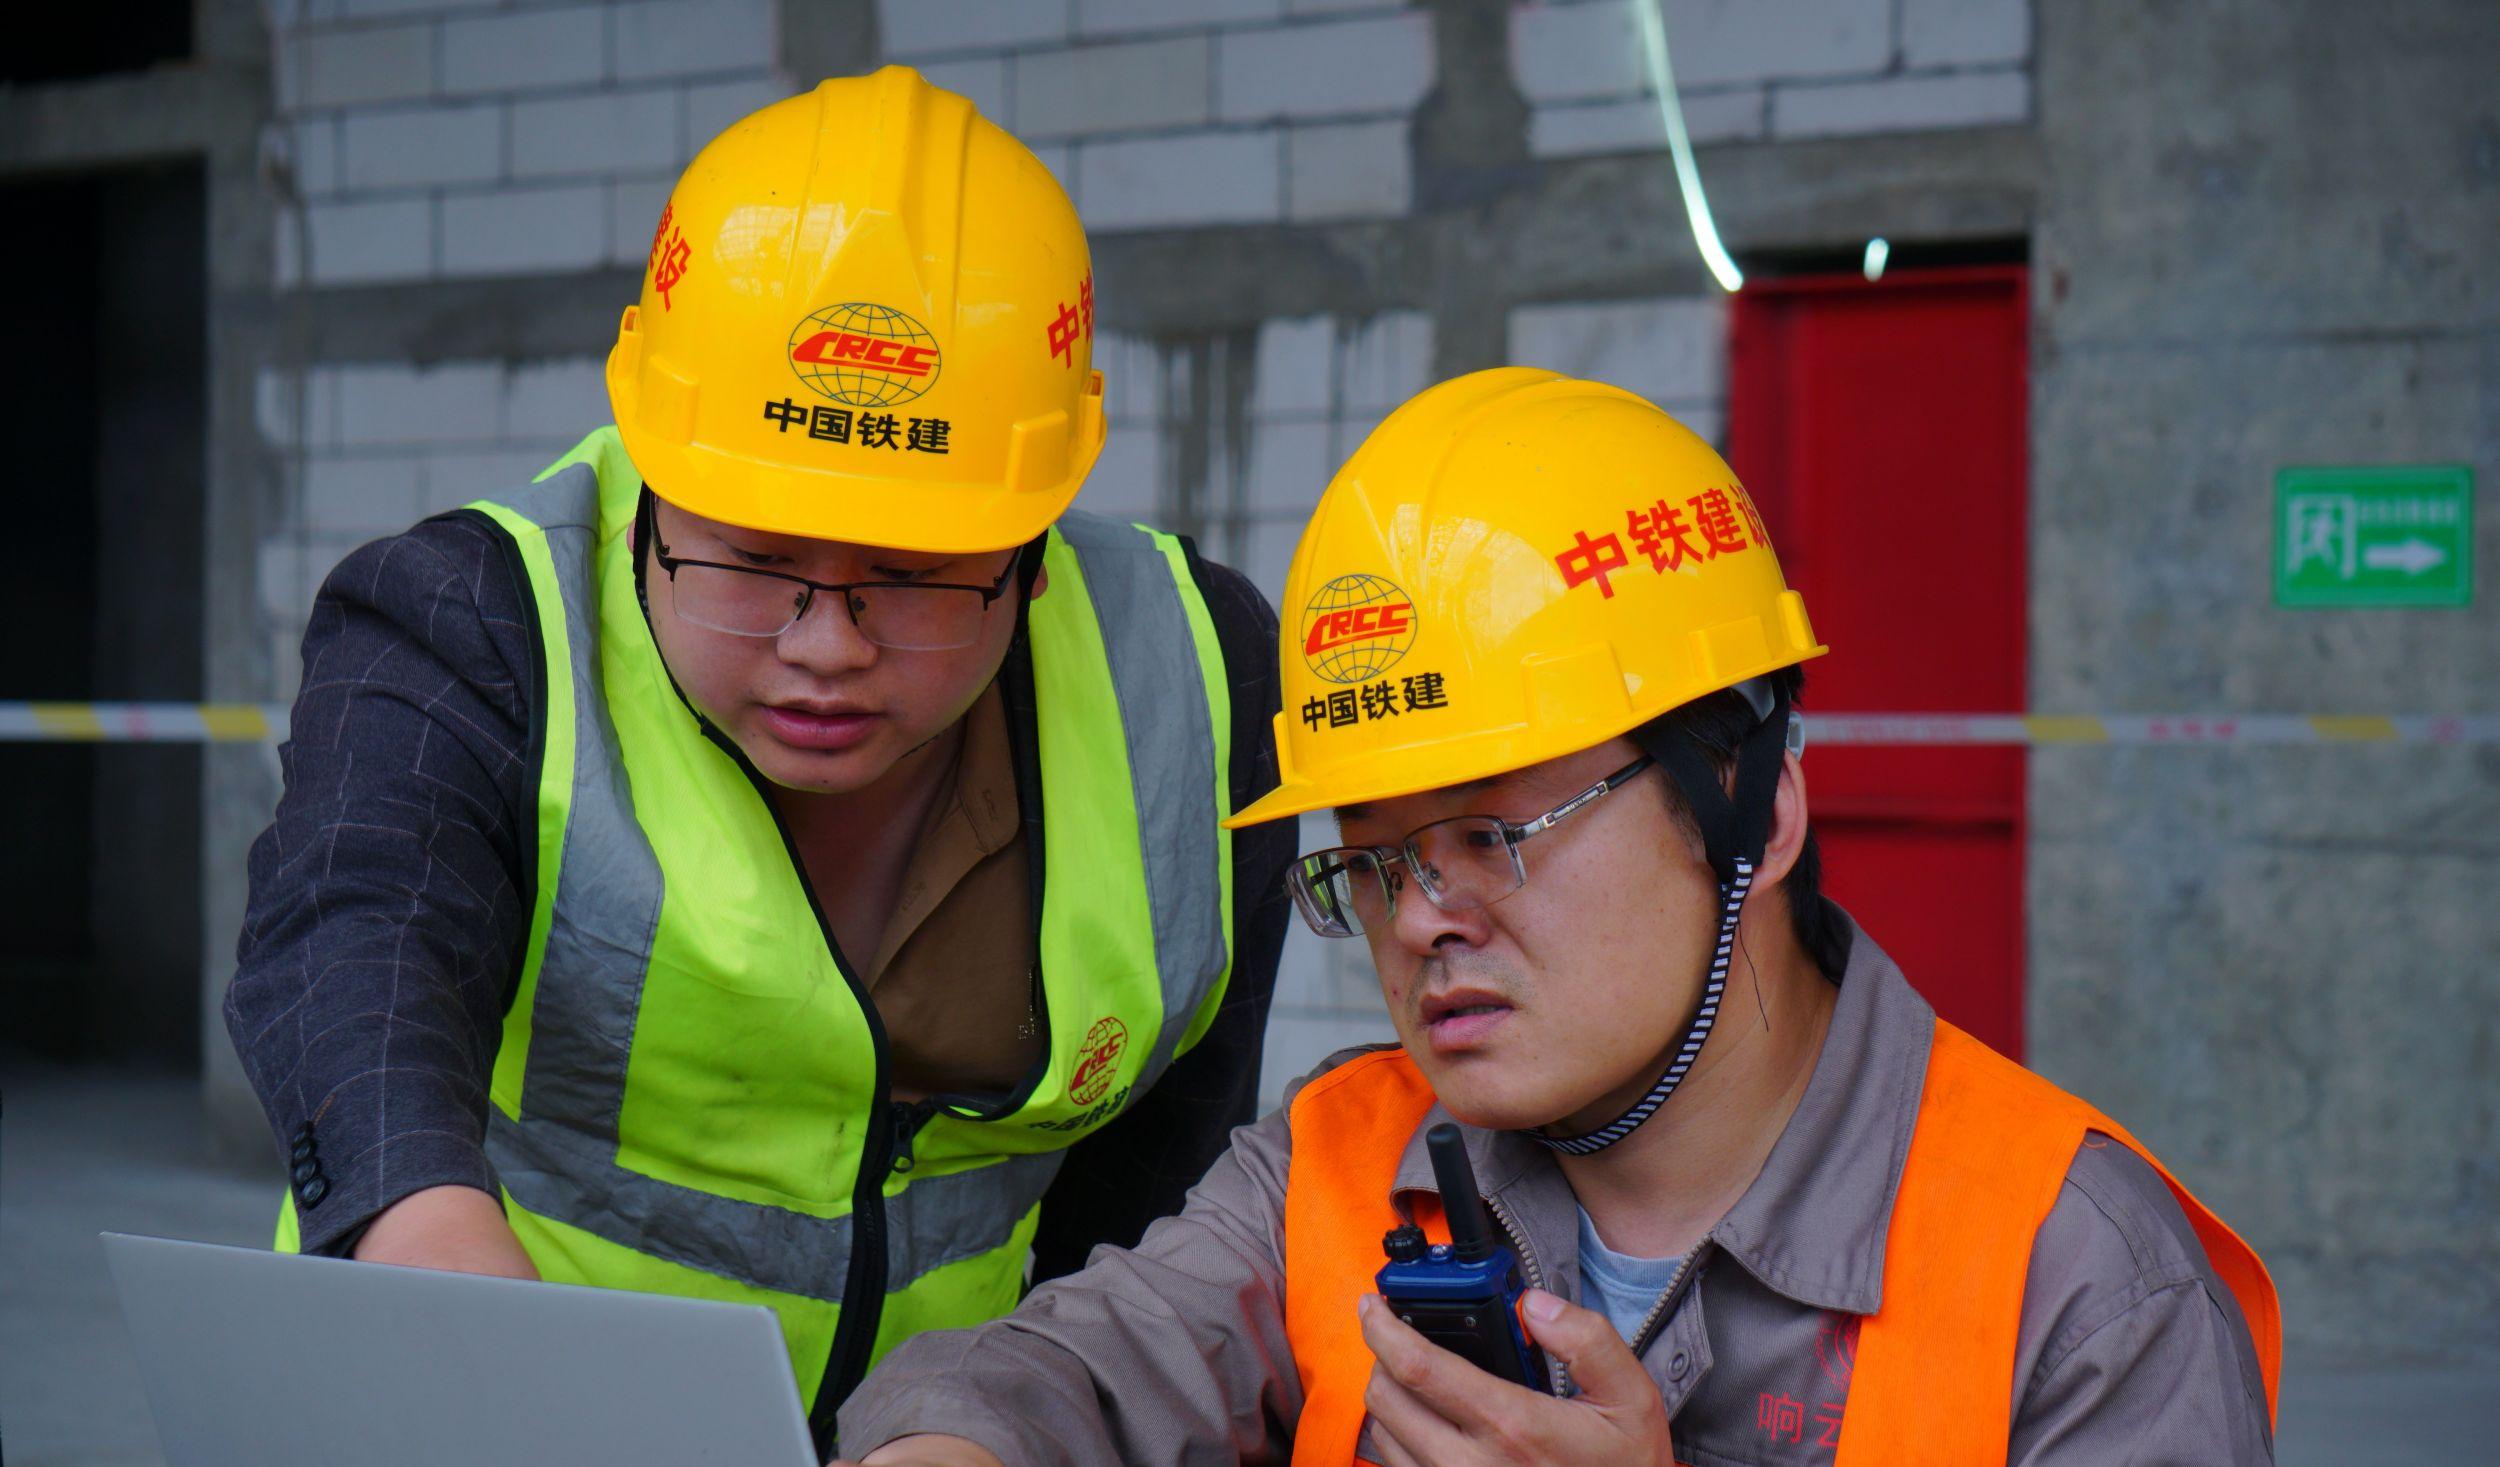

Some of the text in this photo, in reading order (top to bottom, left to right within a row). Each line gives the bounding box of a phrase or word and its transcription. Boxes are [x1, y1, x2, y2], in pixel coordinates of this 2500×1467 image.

[792, 331, 938, 377] CRCC
[763, 397, 951, 455] 中国铁建
[1304, 603, 1412, 656] CRCC
[1301, 672, 1449, 732] 中国铁建
